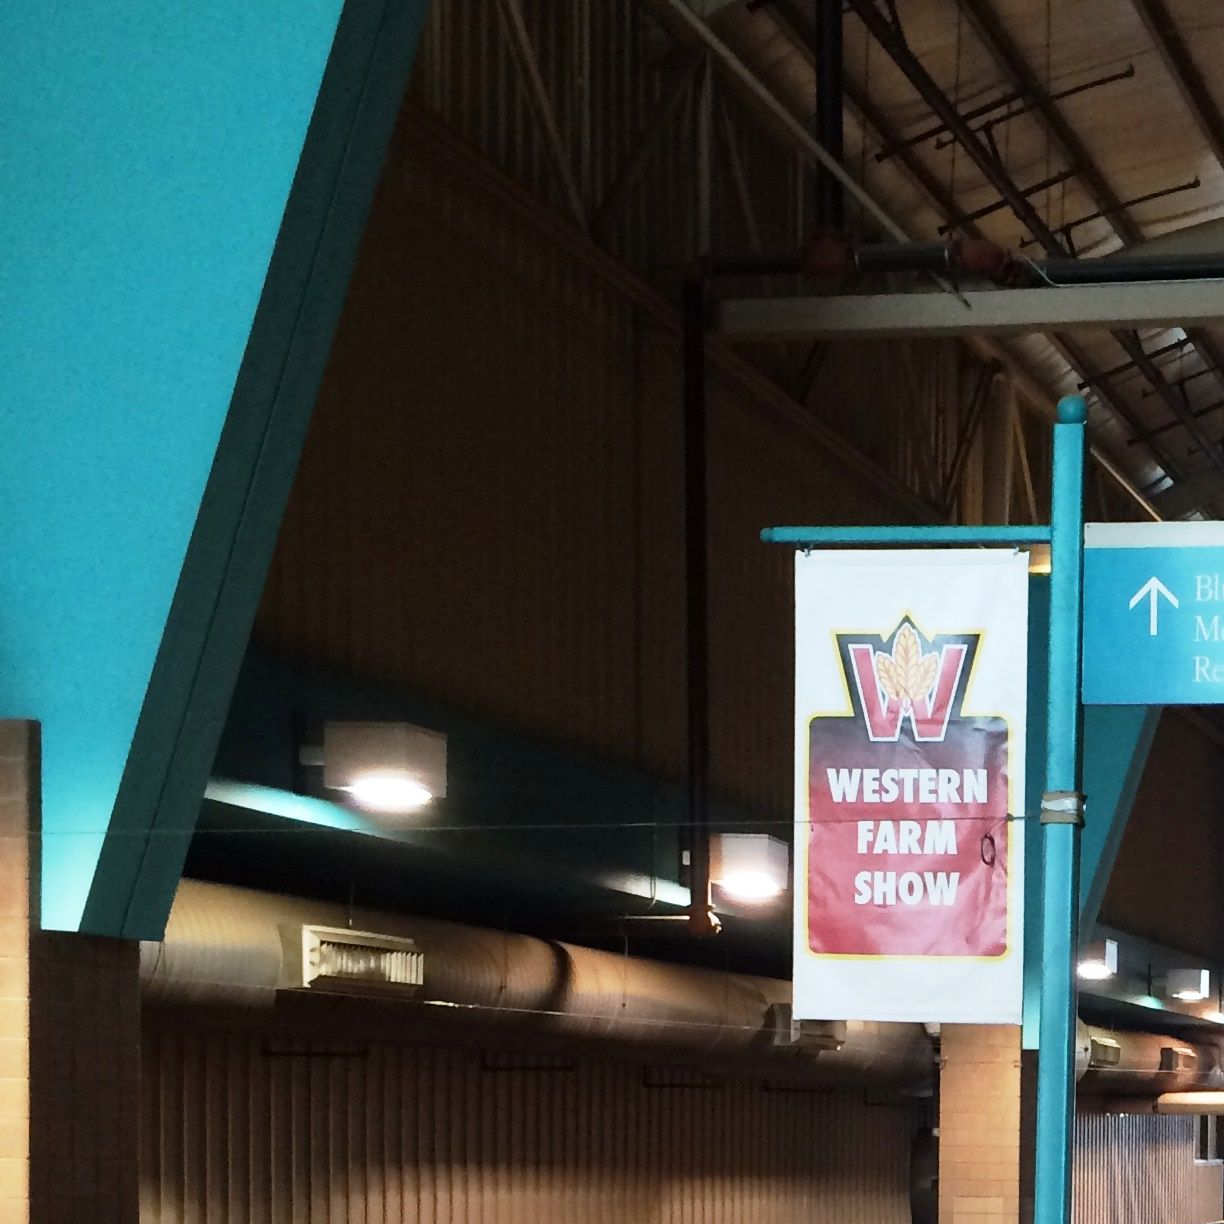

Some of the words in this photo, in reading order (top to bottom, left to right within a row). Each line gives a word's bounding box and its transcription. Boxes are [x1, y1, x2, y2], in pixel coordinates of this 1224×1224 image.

[826, 767, 988, 804] WESTERN
[856, 820, 958, 855] FARM
[854, 871, 960, 906] SHOW
